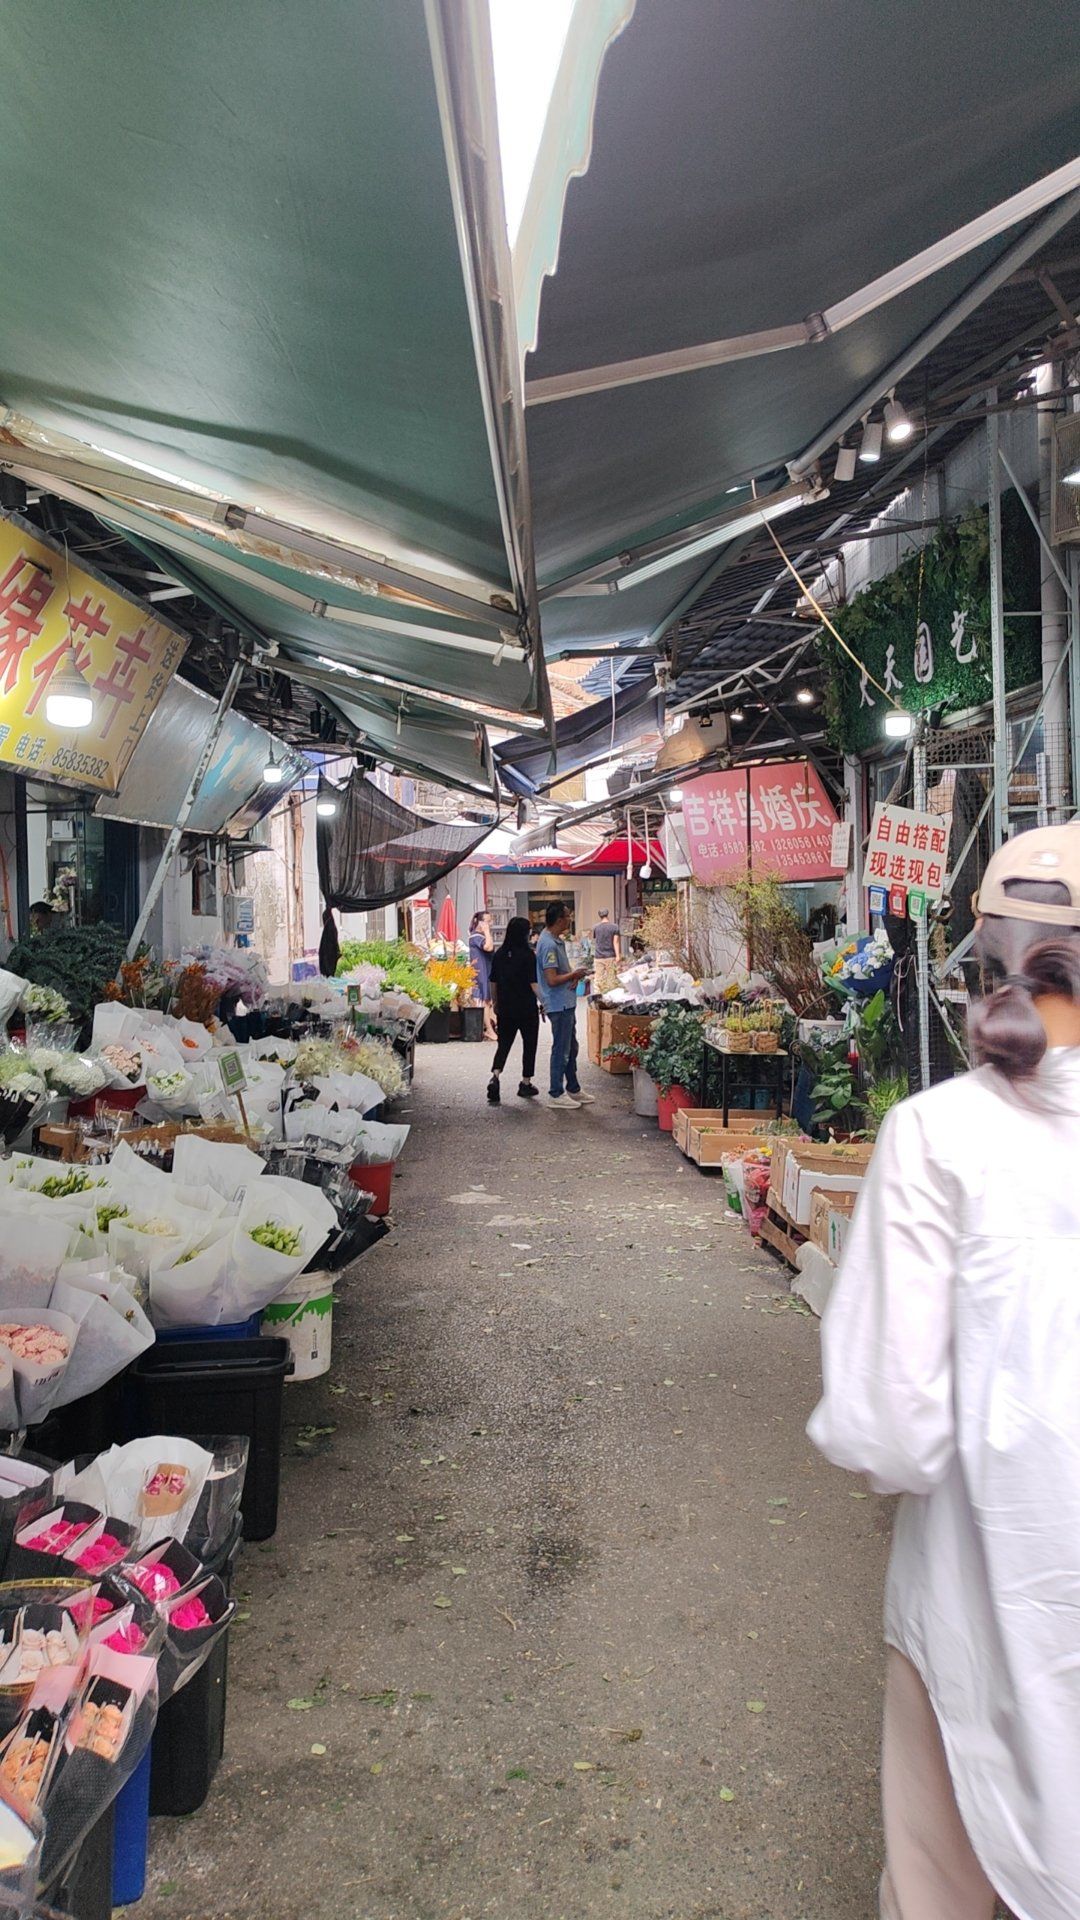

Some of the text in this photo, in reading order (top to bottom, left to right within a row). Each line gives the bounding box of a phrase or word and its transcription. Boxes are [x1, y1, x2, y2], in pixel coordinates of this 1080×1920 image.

[685, 782, 832, 836] 吉祥鸟婚庆
[877, 814, 946, 854] 自由搭配
[869, 851, 941, 888] 现选现包
